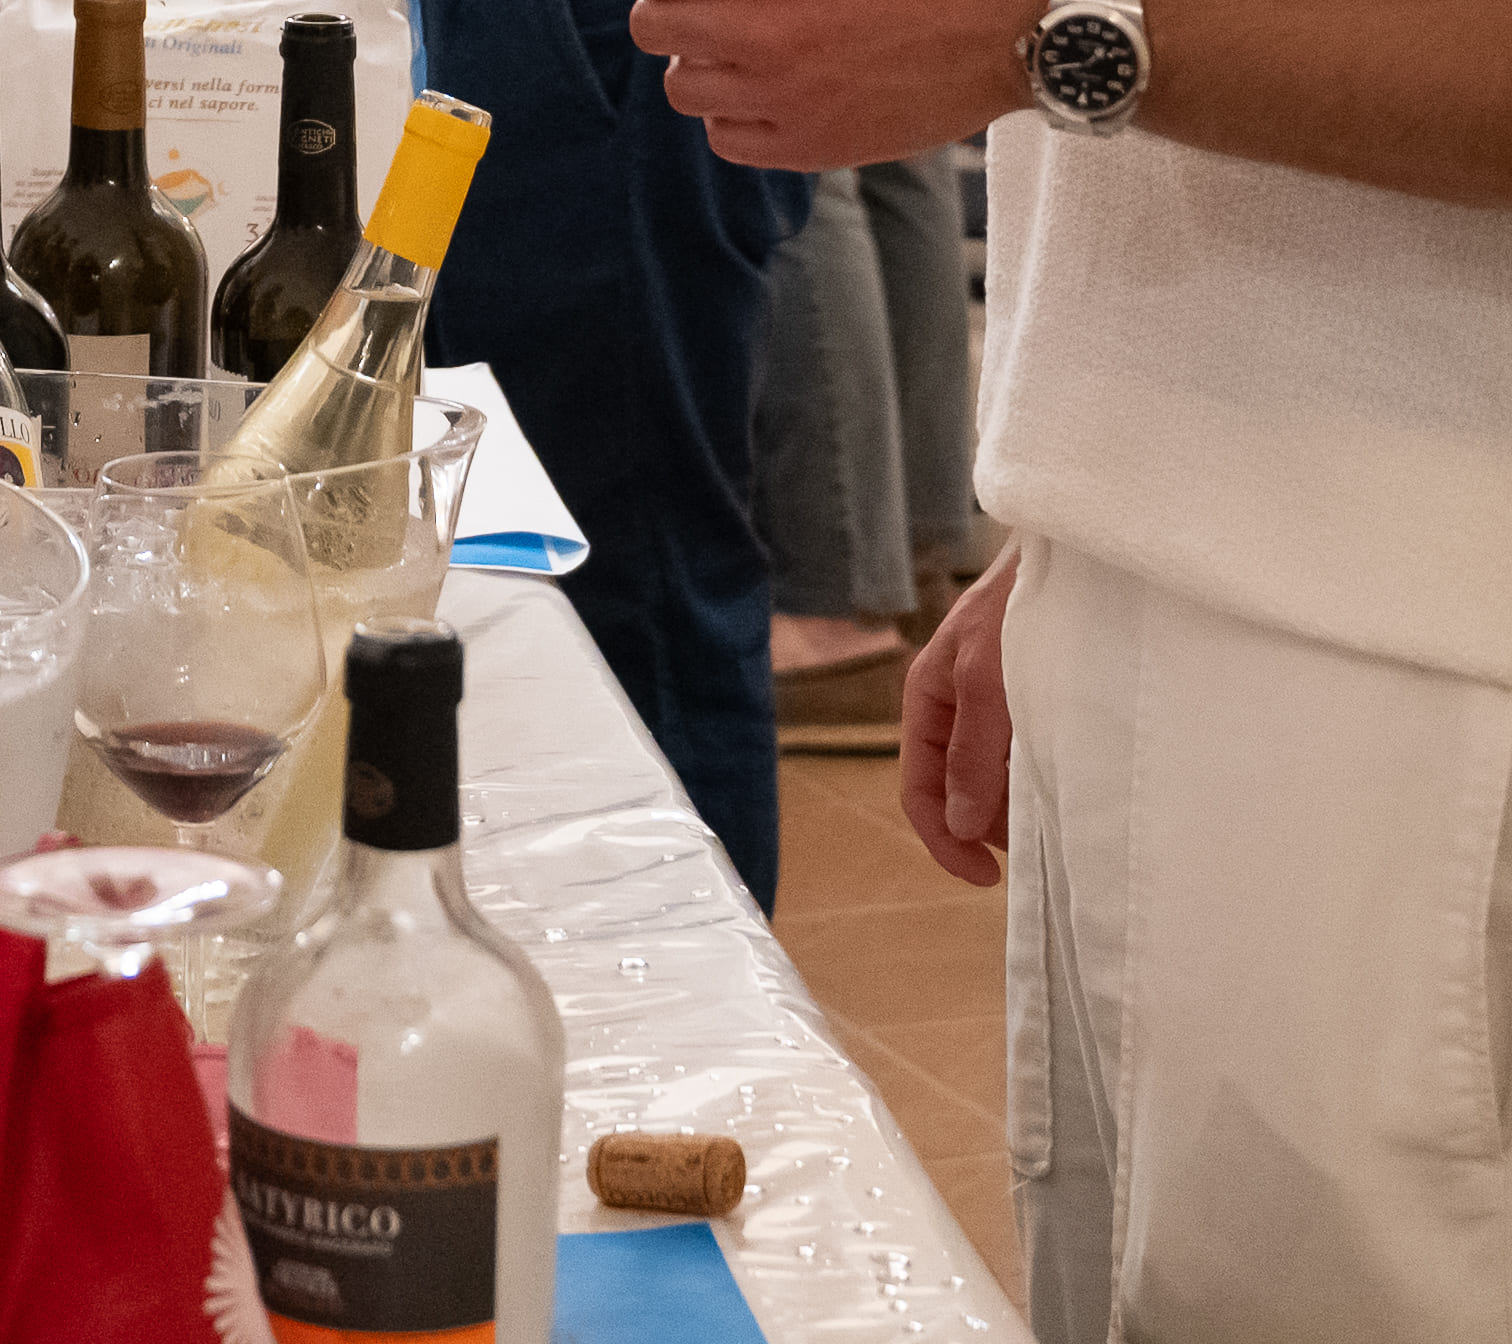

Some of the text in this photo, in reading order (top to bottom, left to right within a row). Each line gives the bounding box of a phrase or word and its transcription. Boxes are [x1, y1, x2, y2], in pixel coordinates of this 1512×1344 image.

[162, 36, 243, 57] Originali
[145, 77, 280, 97] versi nella form
[148, 96, 260, 113] ci nel sapore.
